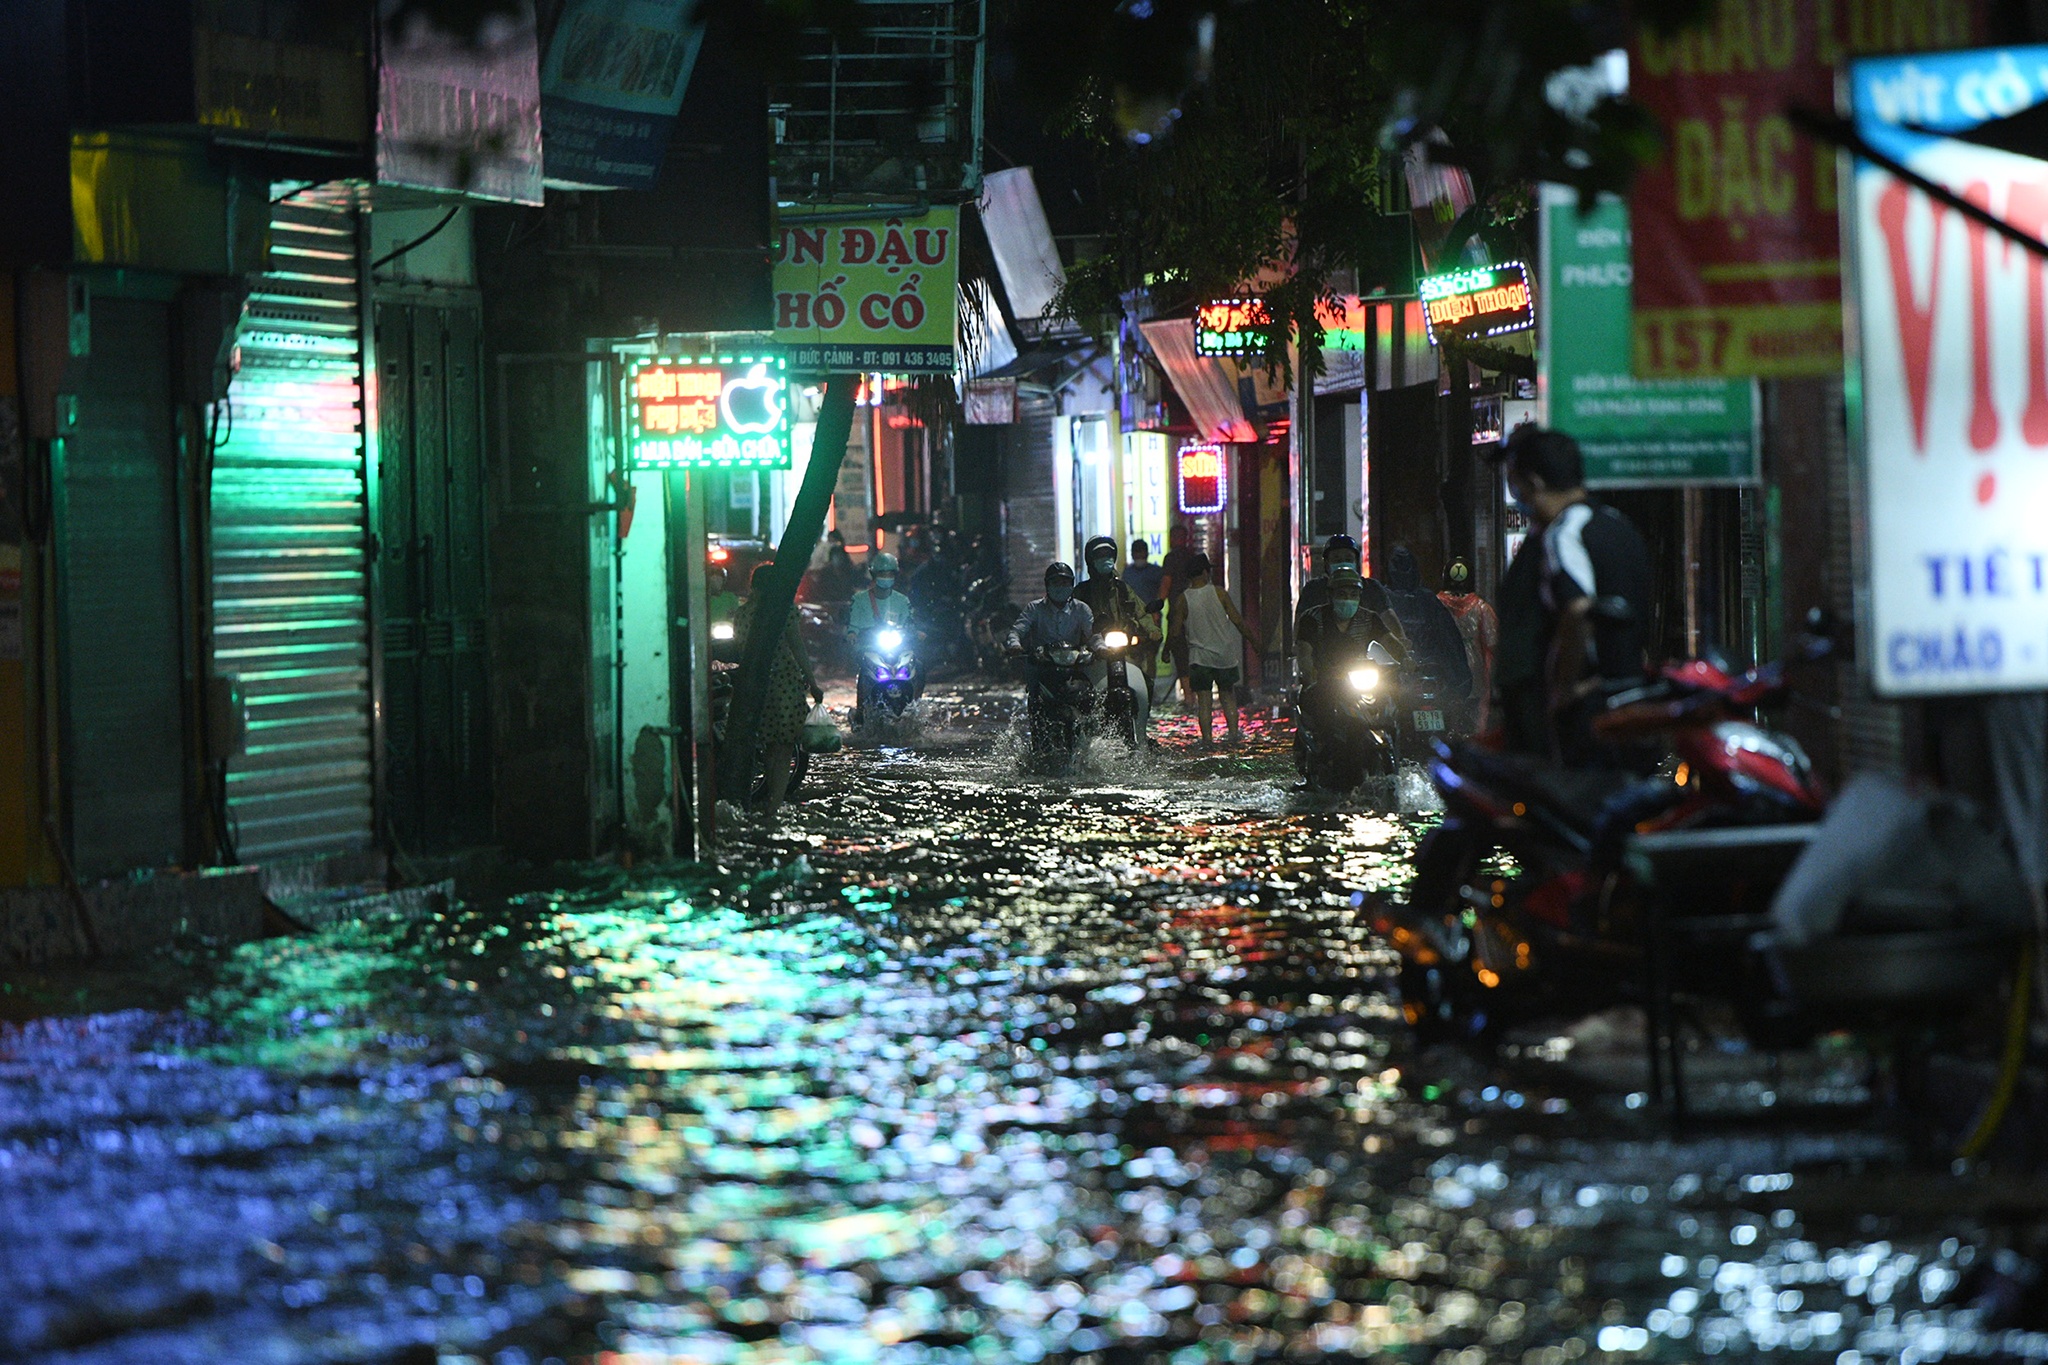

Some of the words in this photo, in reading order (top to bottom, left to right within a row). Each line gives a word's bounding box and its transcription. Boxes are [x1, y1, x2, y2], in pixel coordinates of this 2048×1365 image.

[840, 217, 949, 273] ĐẬU
[776, 275, 848, 329] HỐ
[860, 273, 925, 329] CỔ
[1474, 283, 1528, 314] THOẠI
[823, 346, 853, 365] CẢNH
[882, 351, 901, 365] 091
[904, 352, 923, 366] 436
[926, 352, 952, 366] 3495
[1646, 317, 1732, 371] 157
